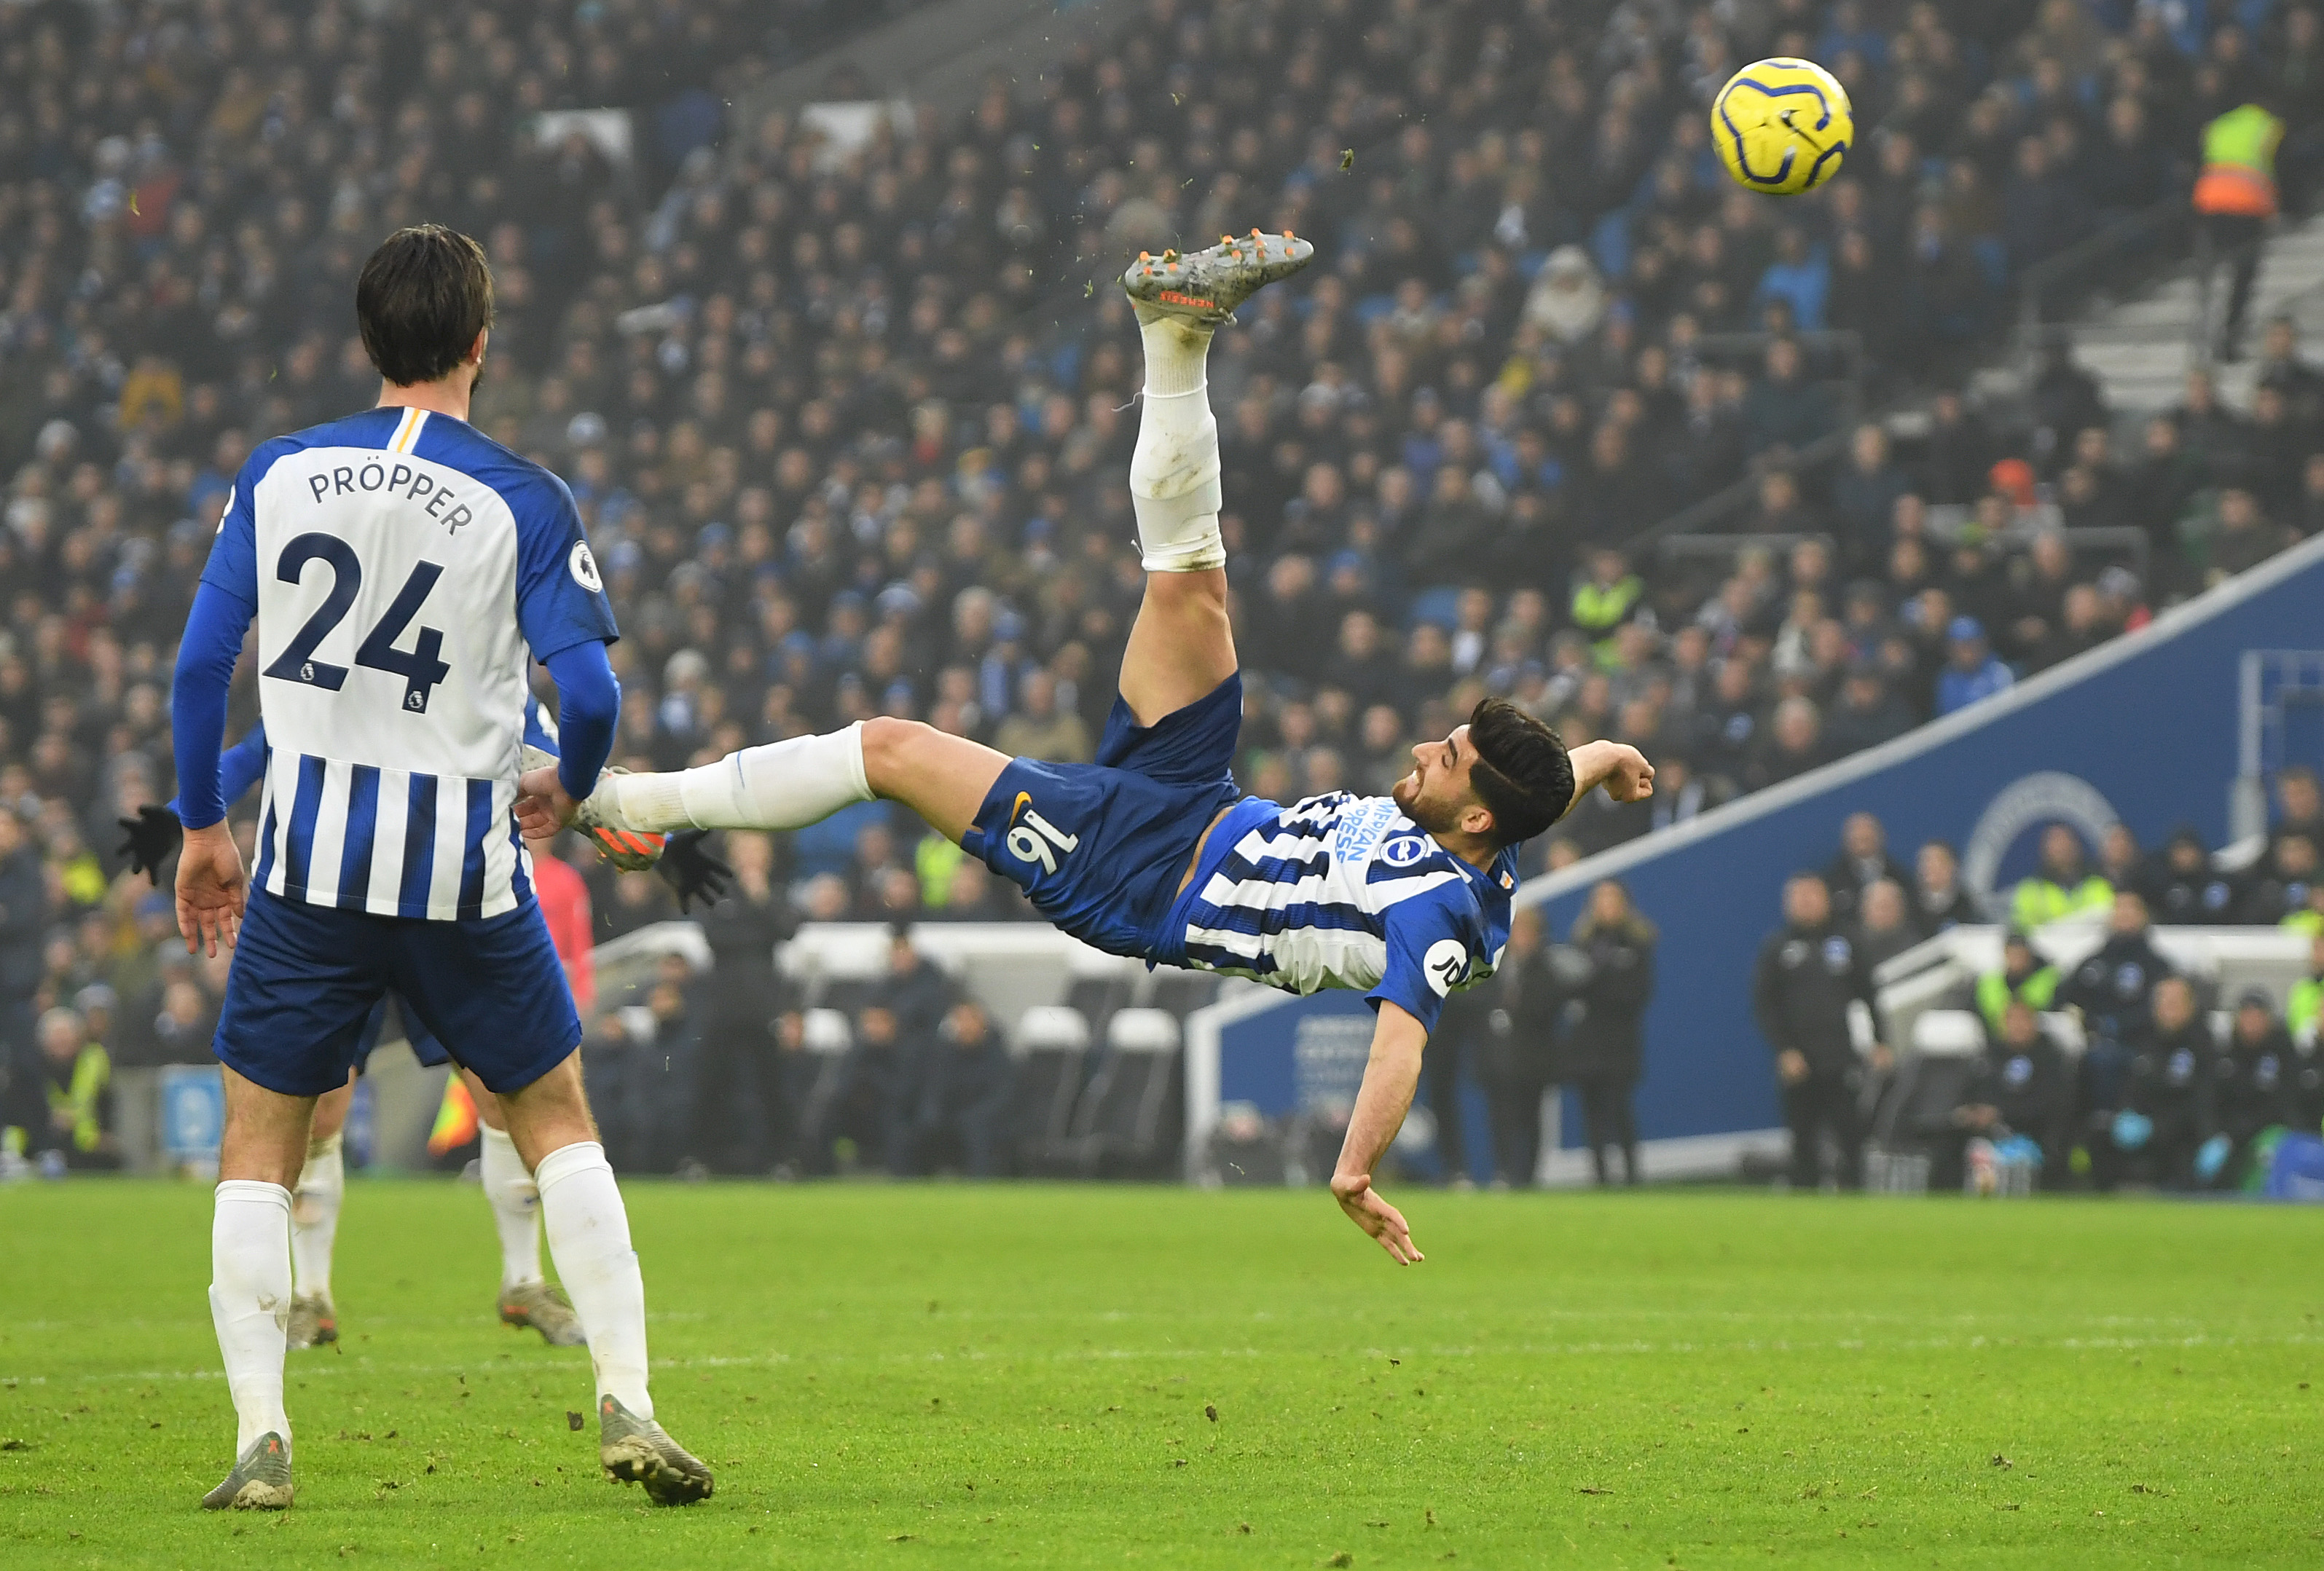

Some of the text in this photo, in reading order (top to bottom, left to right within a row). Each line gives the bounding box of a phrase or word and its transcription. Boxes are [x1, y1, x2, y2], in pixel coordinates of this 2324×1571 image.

[308, 456, 474, 536] PRÖPPER
[262, 532, 452, 714] 24
[1006, 808, 1080, 875] 16
[1348, 799, 1397, 861] MERICAN
[1431, 955, 1460, 988] JD
